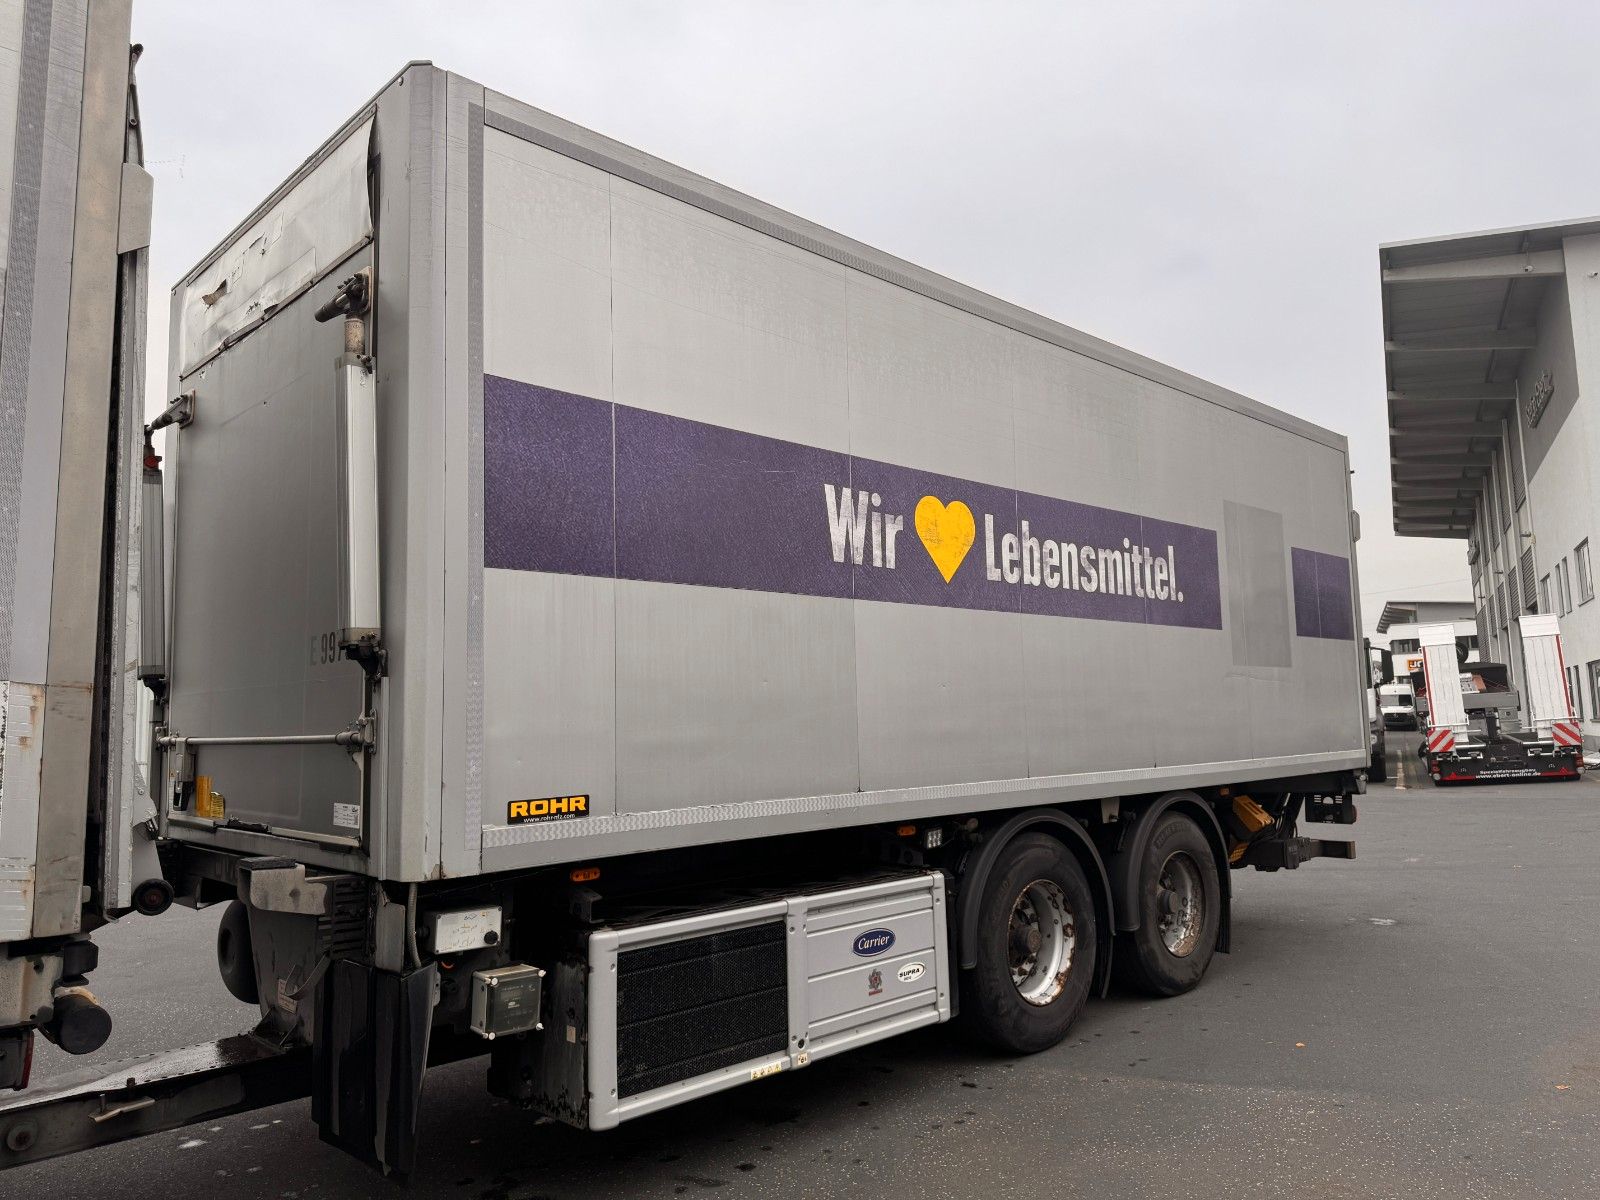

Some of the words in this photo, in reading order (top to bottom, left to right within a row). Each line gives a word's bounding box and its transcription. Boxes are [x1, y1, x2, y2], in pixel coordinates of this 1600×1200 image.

[824, 483, 904, 570] Wir
[984, 513, 1185, 603] Lebensmittel.
[1475, 771, 1542, 779] www.ebert-online.de
[510, 796, 587, 818] ROHR
[858, 934, 890, 951] Carrier
[899, 967, 921, 978] SUPRA
